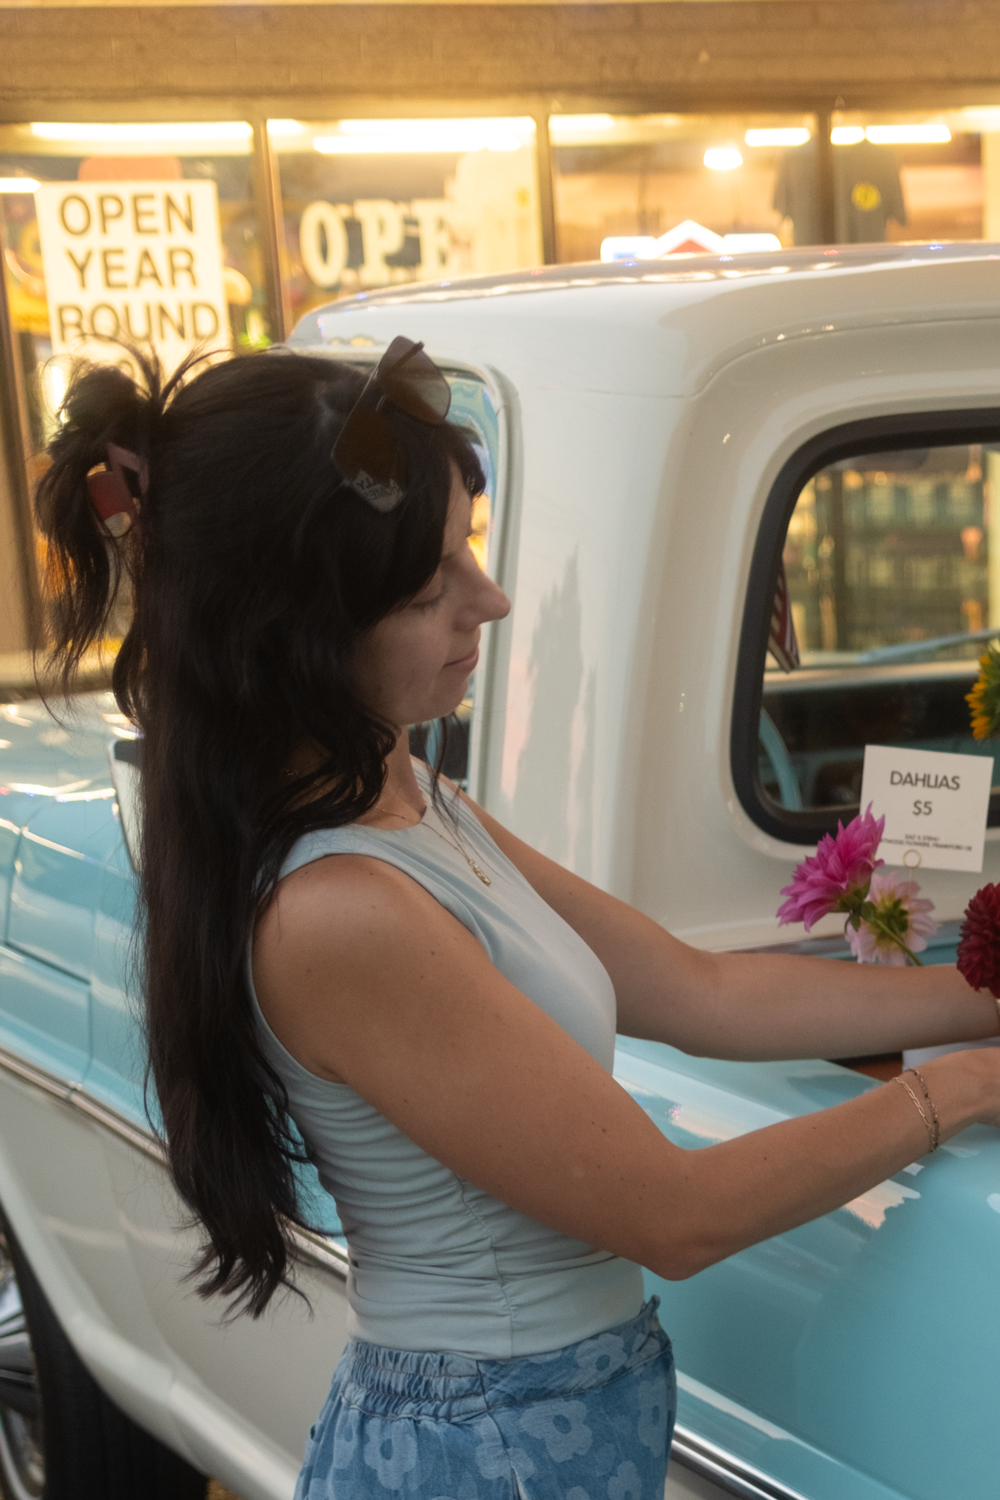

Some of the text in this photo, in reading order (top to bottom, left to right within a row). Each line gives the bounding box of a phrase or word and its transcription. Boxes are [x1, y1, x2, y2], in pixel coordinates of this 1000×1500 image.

[58, 193, 196, 239] OPEN
[65, 246, 196, 290] YEAR
[57, 301, 220, 343] ROUND
[889, 769, 961, 791] DAHLIAS
[912, 799, 933, 816] $5
